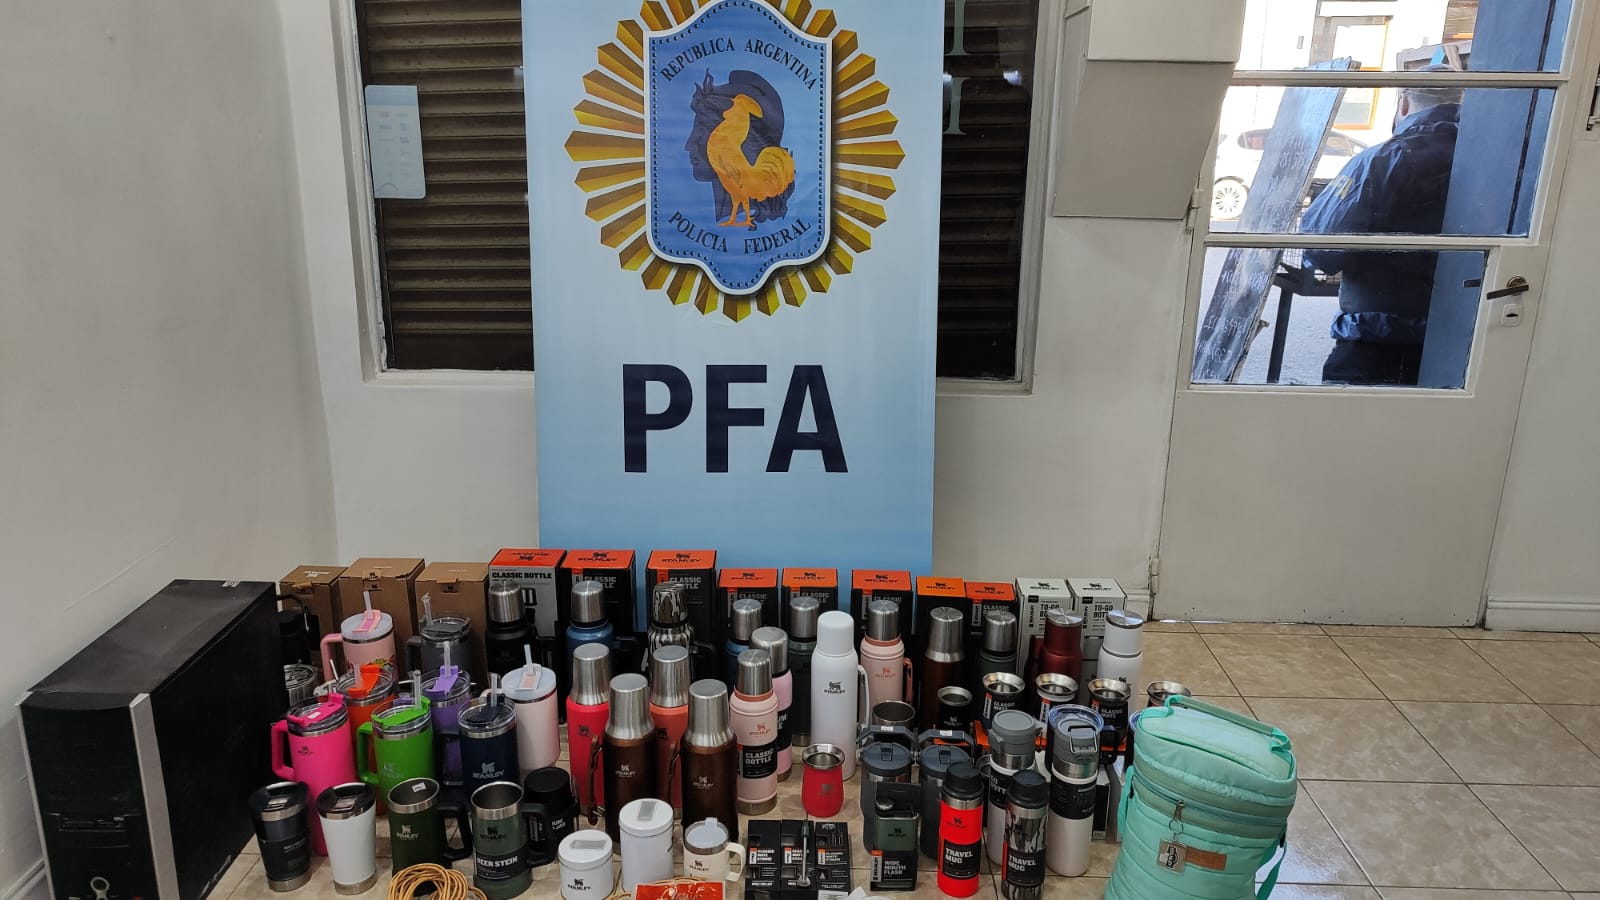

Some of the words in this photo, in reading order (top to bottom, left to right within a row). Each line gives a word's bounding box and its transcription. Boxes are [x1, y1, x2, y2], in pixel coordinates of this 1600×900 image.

[660, 37, 735, 82] REPUBLICA
[744, 37, 818, 91] ARGENTINA
[668, 210, 728, 253] POLICIA
[744, 219, 812, 254] FEDERAL
[622, 363, 849, 473] PFA
[745, 748, 774, 759] CLASSIC
[745, 756, 771, 765] BOTTLE
[473, 769, 505, 779] STANLEY
[945, 847, 974, 858] TRAVEL
[495, 855, 518, 868] STEIN
[945, 854, 963, 864] MUG
[1008, 854, 1038, 866] TRAVEL
[1008, 861, 1026, 872] MUG
